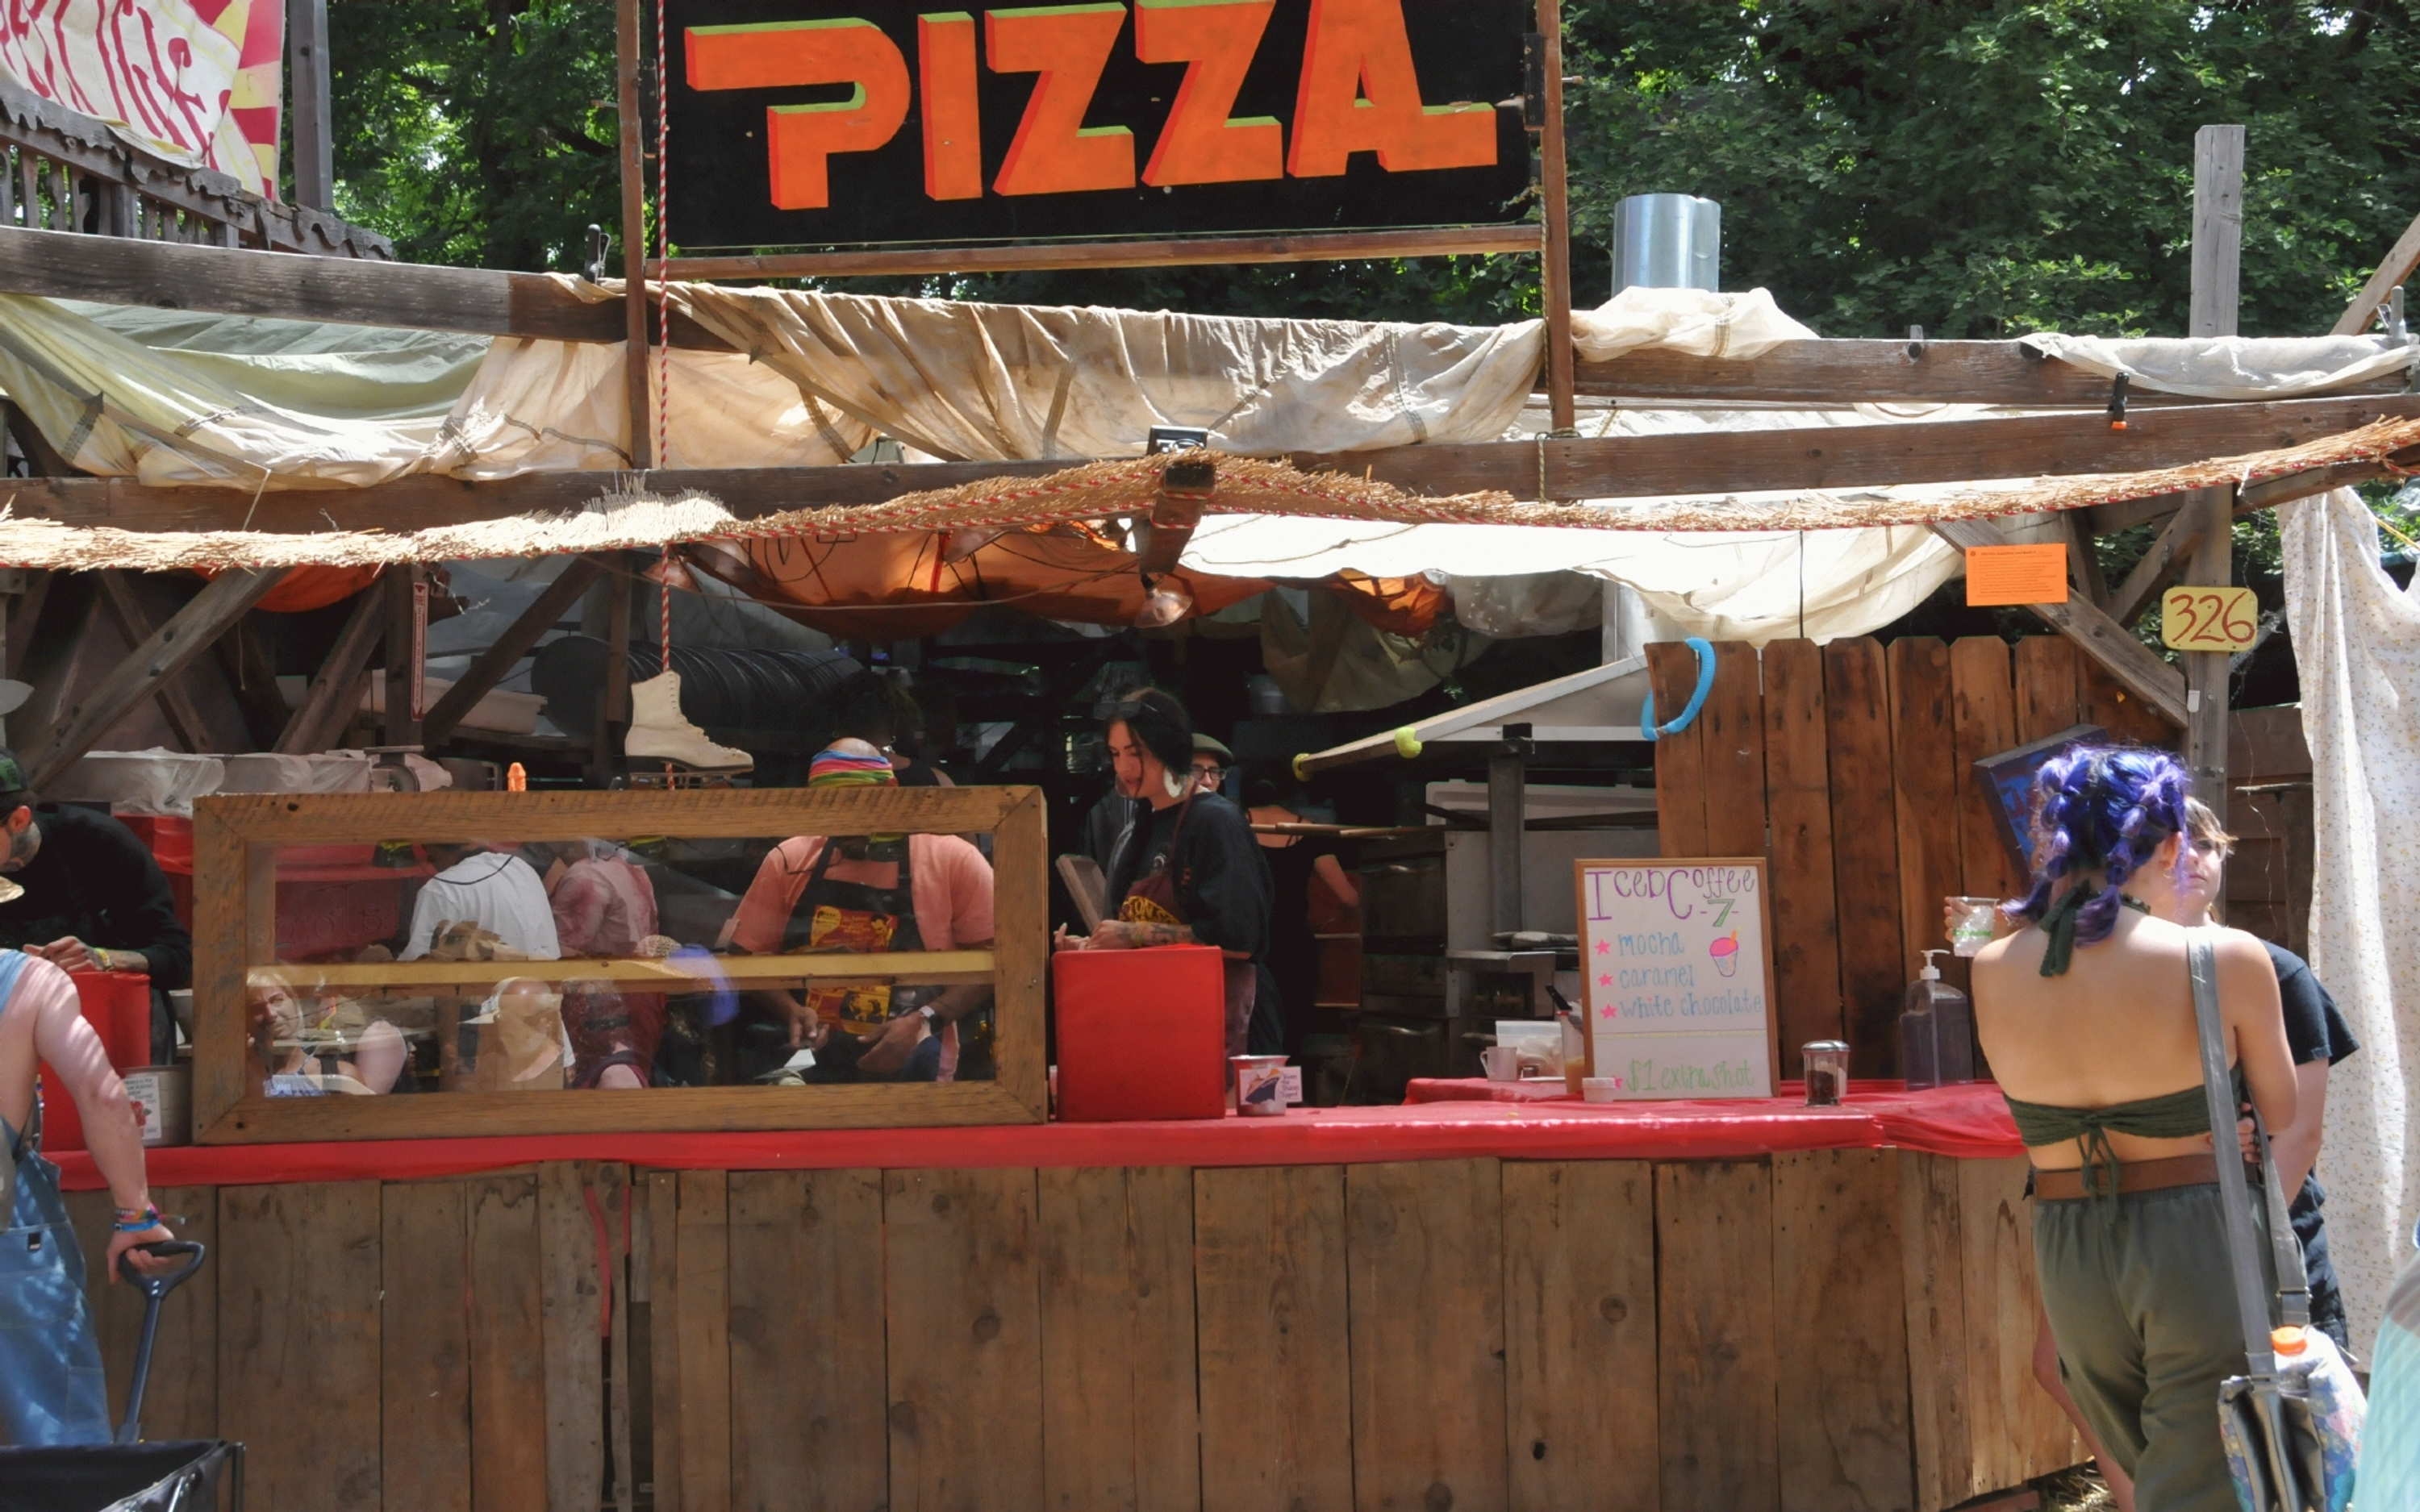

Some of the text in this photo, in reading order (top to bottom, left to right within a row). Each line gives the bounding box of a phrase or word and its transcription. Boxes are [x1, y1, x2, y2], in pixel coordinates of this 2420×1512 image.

[685, 0, 1498, 210] PIZZA
[2170, 591, 2255, 644] 326
[1667, 867, 1755, 920] Coffee
[1618, 931, 1685, 956] mocha
[1619, 964, 1695, 989] caramel
[1619, 989, 1763, 1018] white chocolate
[1626, 1059, 1755, 1093] $1 extra shot
